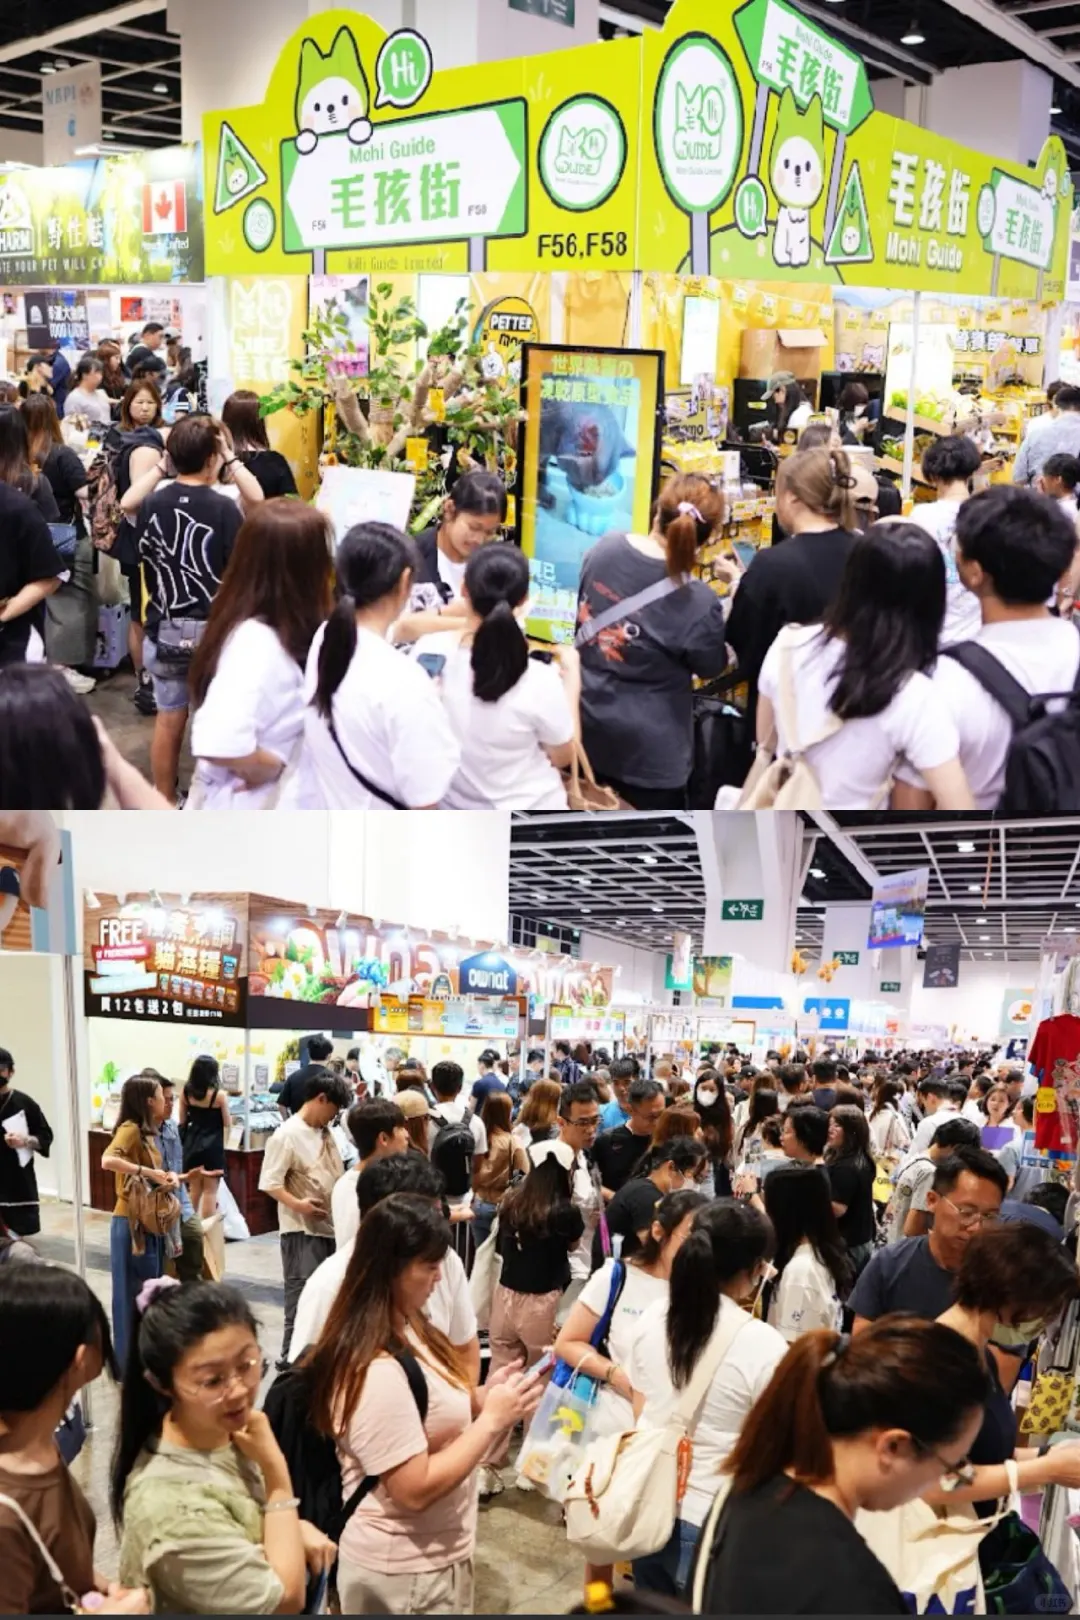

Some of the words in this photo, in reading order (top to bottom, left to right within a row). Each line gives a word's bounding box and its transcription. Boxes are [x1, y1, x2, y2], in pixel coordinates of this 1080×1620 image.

[391, 50, 419, 89] Hi
[775, 34, 844, 114] 毛孩街
[390, 138, 436, 160] Guide
[330, 161, 461, 230] 毛孩街
[888, 151, 970, 237] 毛孩街
[537, 232, 628, 259] F56,F58
[886, 232, 921, 267] Mohi
[926, 239, 963, 273] Guide
[99, 919, 143, 947] FREE
[468, 968, 509, 991] ownat
